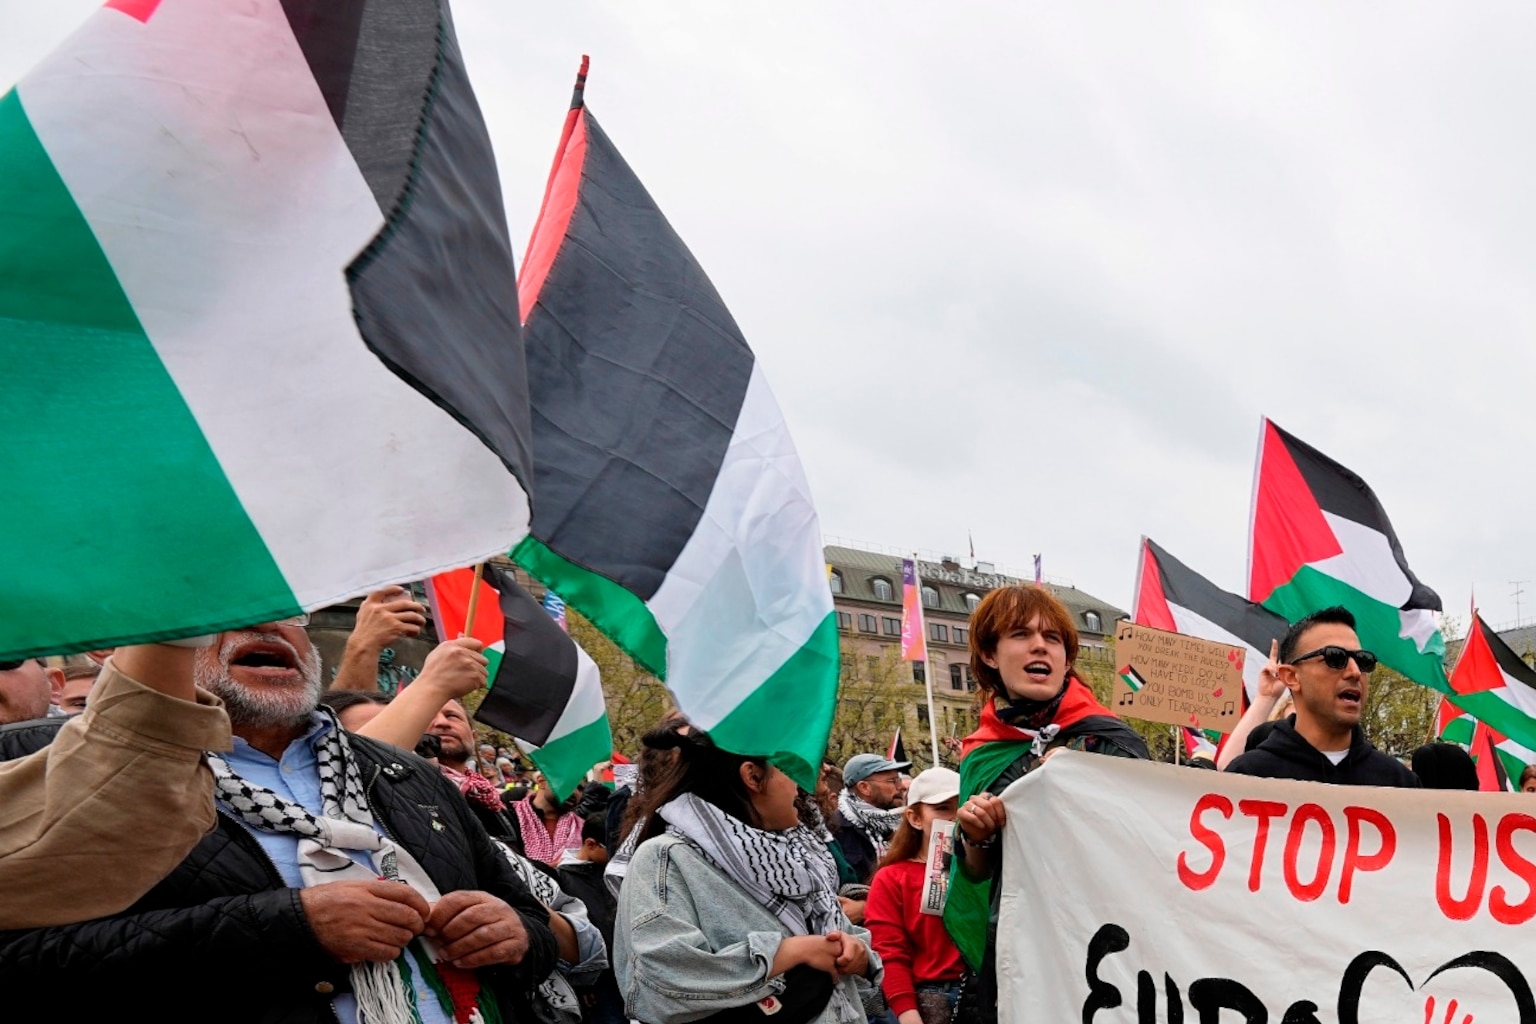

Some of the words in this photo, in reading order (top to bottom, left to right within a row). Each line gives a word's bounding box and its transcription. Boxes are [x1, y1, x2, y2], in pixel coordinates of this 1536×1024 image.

[1134, 630, 1155, 643] HOW
[1180, 639, 1205, 653] TIMES
[1208, 647, 1225, 658] WILL
[1138, 643, 1152, 652] YOU
[1184, 652, 1198, 662] THE
[1131, 654, 1150, 665] HOW
[1172, 662, 1194, 675] KIDS
[1199, 668, 1214, 678] DO
[1215, 673, 1228, 682] WE
[1150, 669, 1174, 681] HAVE
[1176, 674, 1187, 684] TO
[1191, 678, 1217, 690] LOSE?
[1139, 694, 1164, 708] ONLY
[1146, 682, 1165, 694] YOU
[1168, 685, 1194, 699] BOMB
[1177, 793, 1398, 904] STOP
